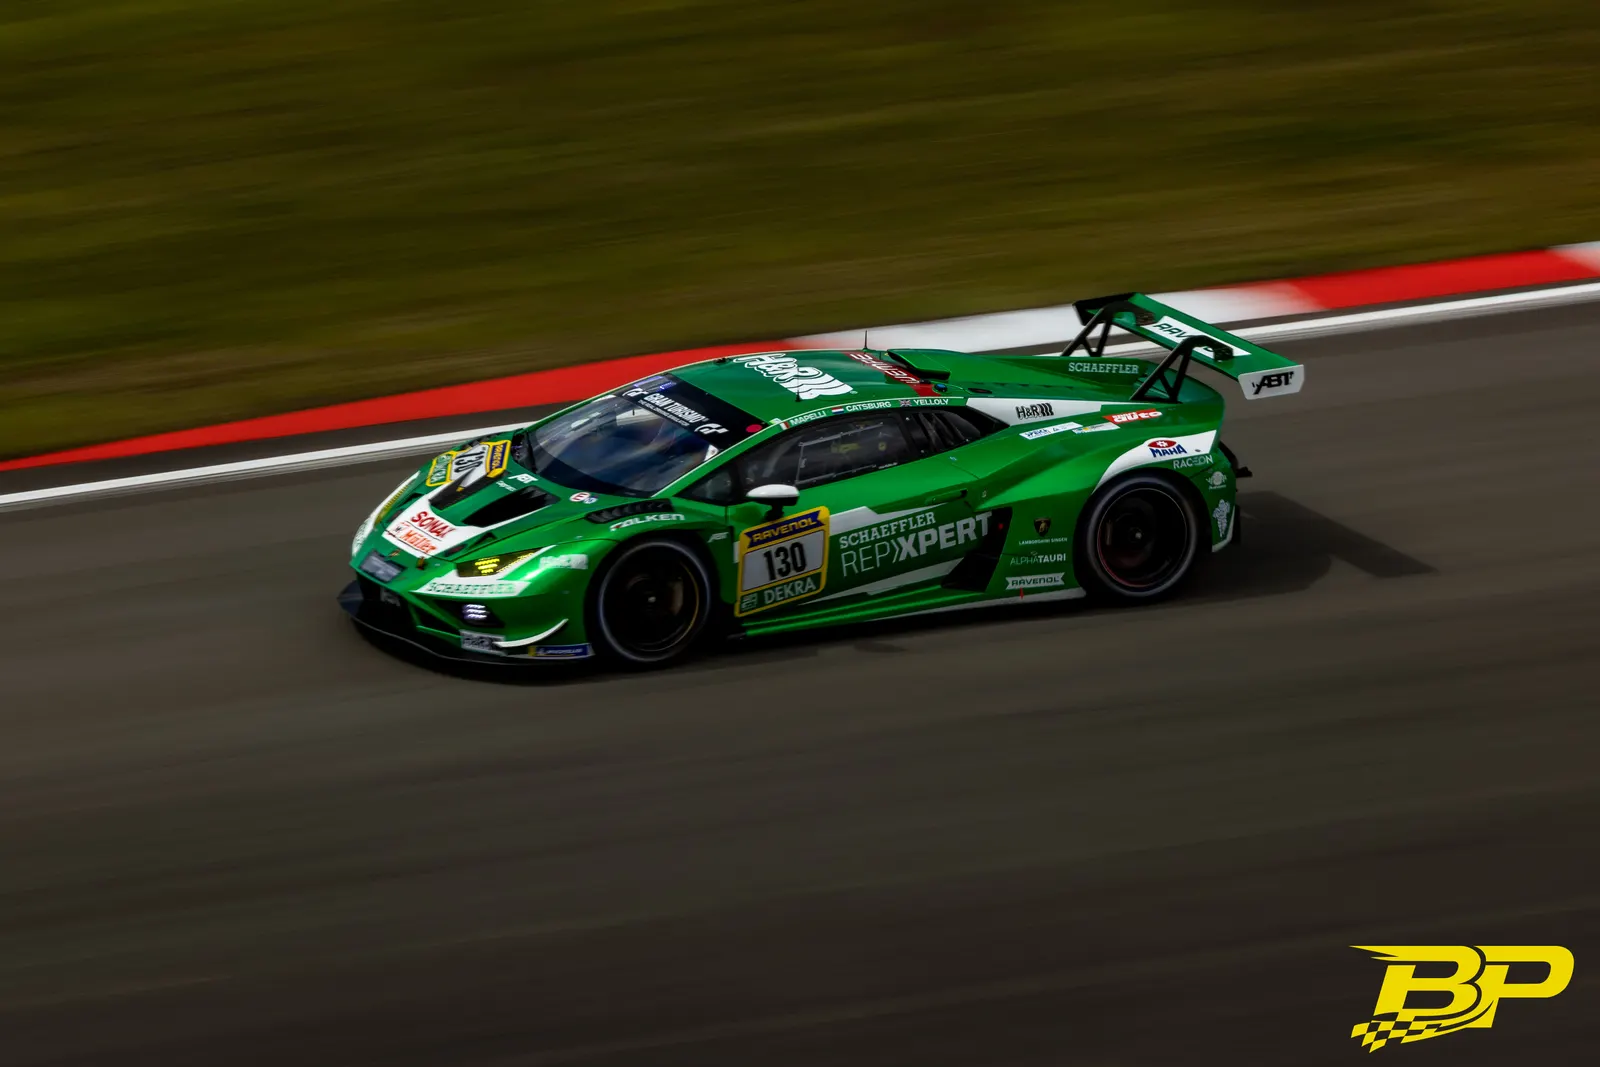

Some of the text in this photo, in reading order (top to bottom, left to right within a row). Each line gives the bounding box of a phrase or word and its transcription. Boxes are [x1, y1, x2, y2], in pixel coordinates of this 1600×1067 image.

[1068, 361, 1140, 375] SCHAEFFLER
[788, 398, 949, 426] MAPELLI CATSBURG YELLOLY
[453, 451, 486, 473] 130
[1149, 444, 1187, 458] MAHA
[610, 513, 686, 532] FALKEN
[752, 517, 818, 543] RAVENOL
[838, 511, 937, 549] SCHAEFFLER
[763, 541, 808, 581] 130
[763, 576, 817, 605] DEKRA
[1010, 576, 1061, 588] RAVENOL
